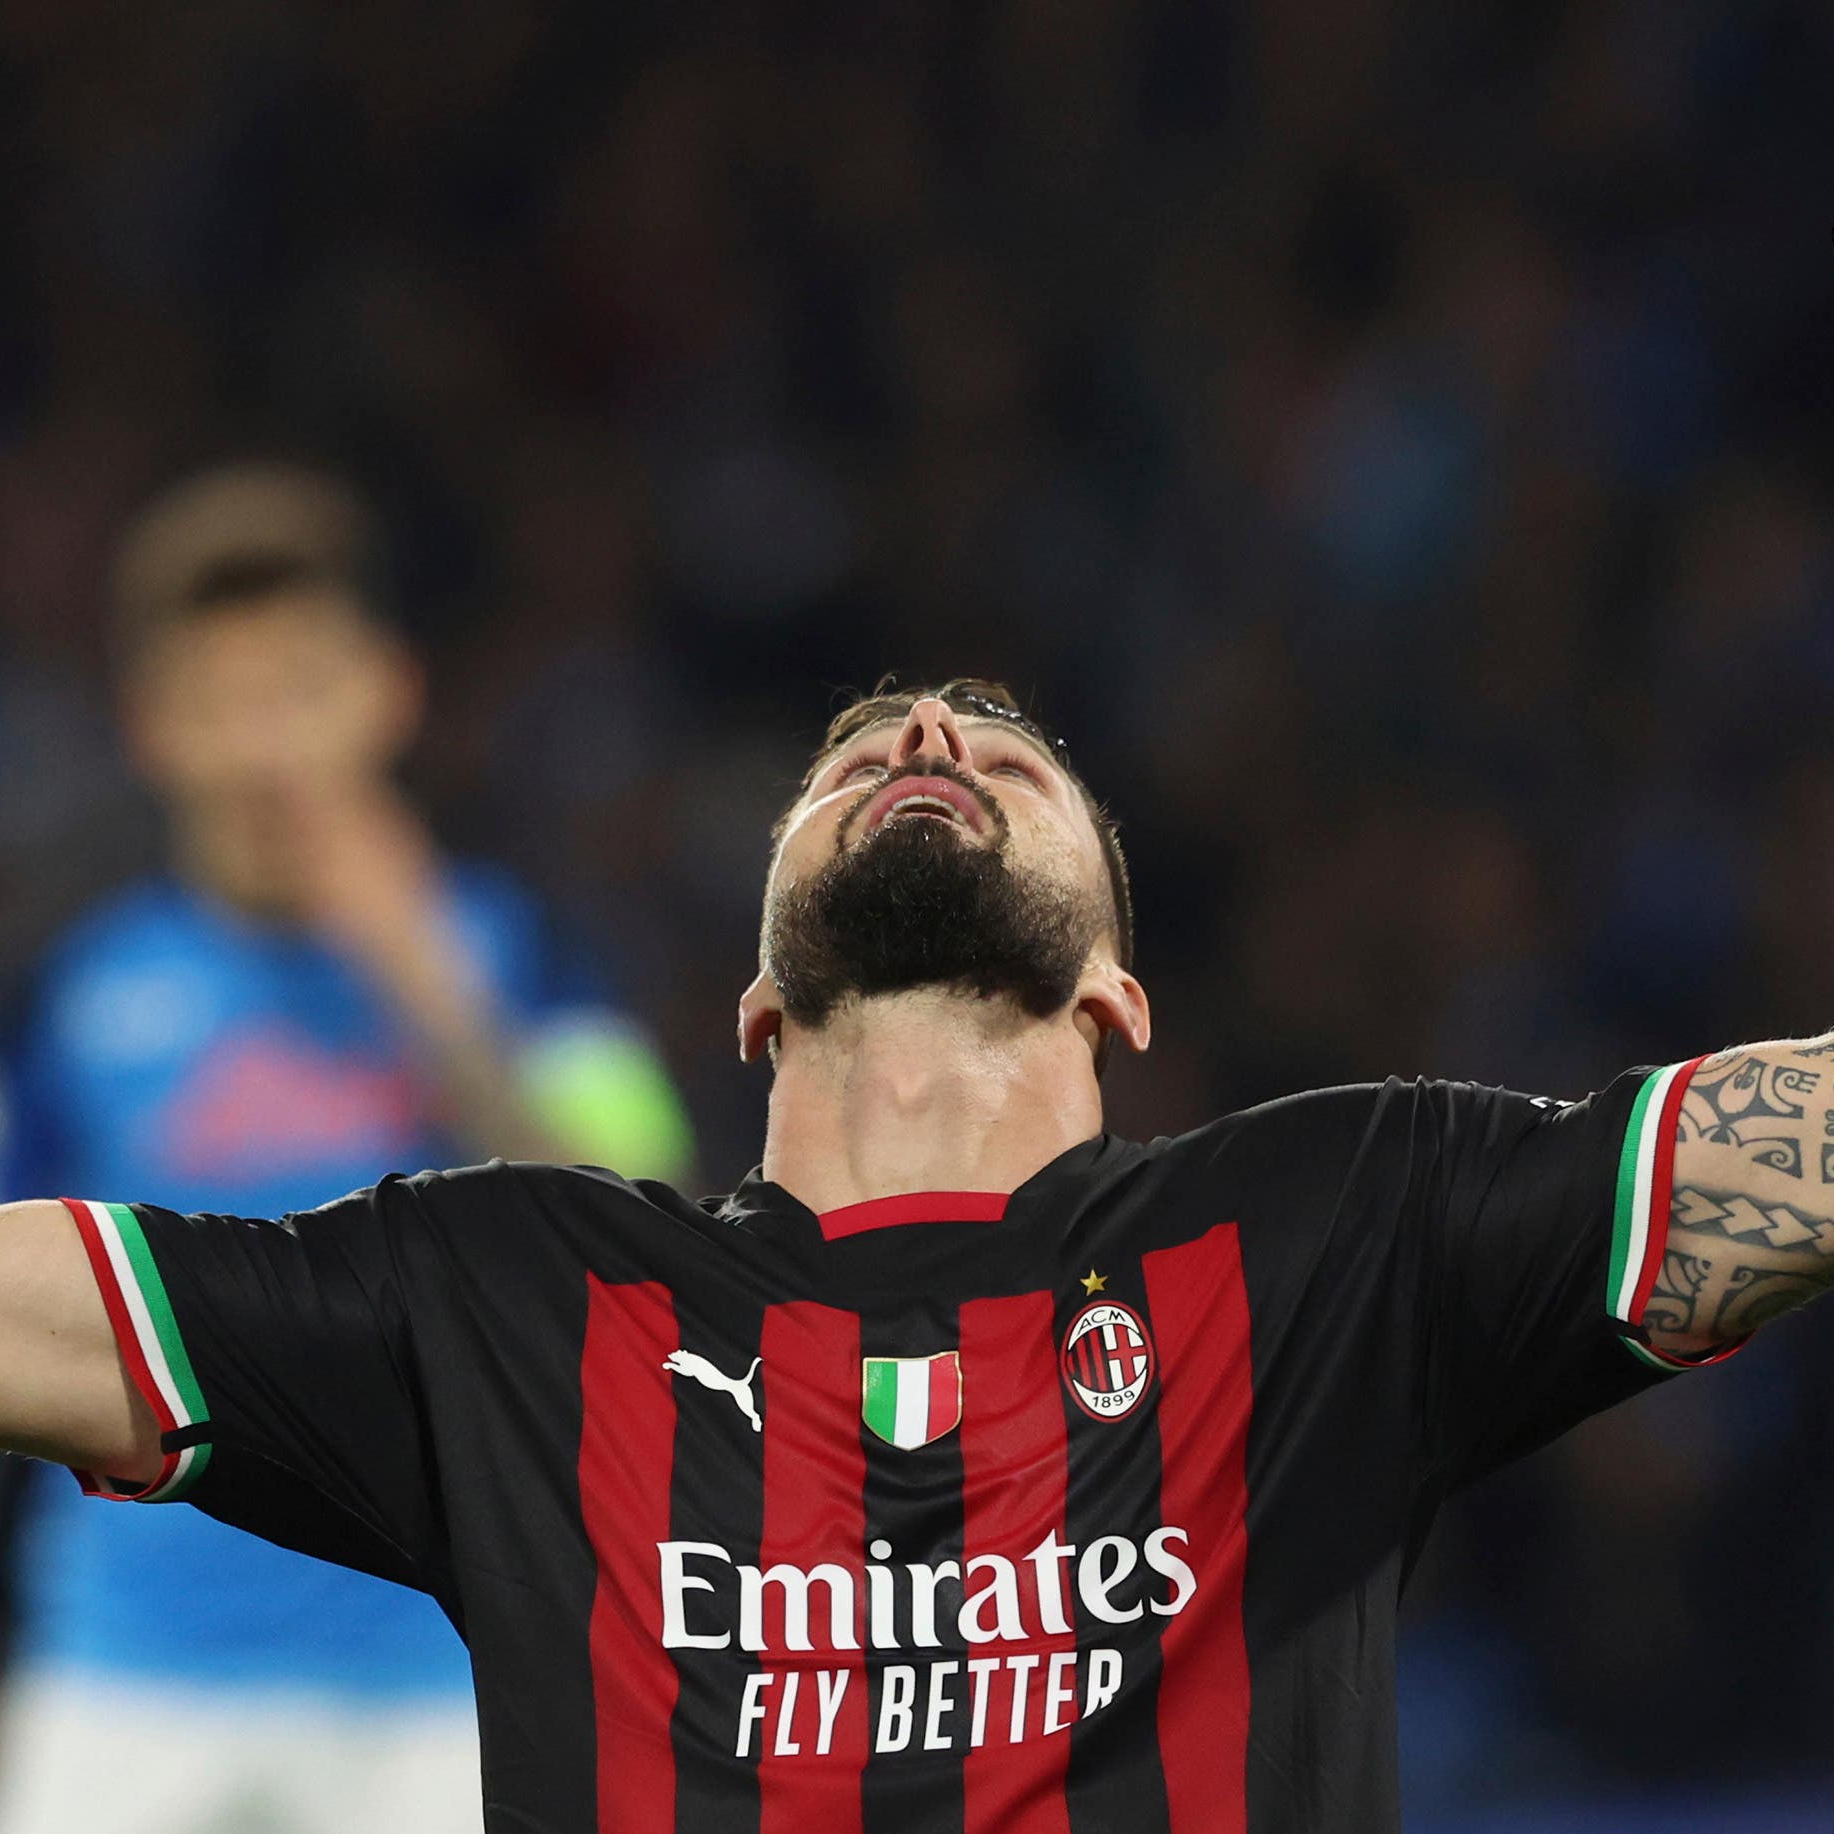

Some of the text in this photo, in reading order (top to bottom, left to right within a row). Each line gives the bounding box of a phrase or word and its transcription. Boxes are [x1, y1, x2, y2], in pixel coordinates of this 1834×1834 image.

[1078, 1309, 1126, 1332] ACM
[1092, 1390, 1135, 1409] 1899
[656, 1526, 1198, 1652] Emirates
[735, 1649, 1123, 1758] FLY BETTER
